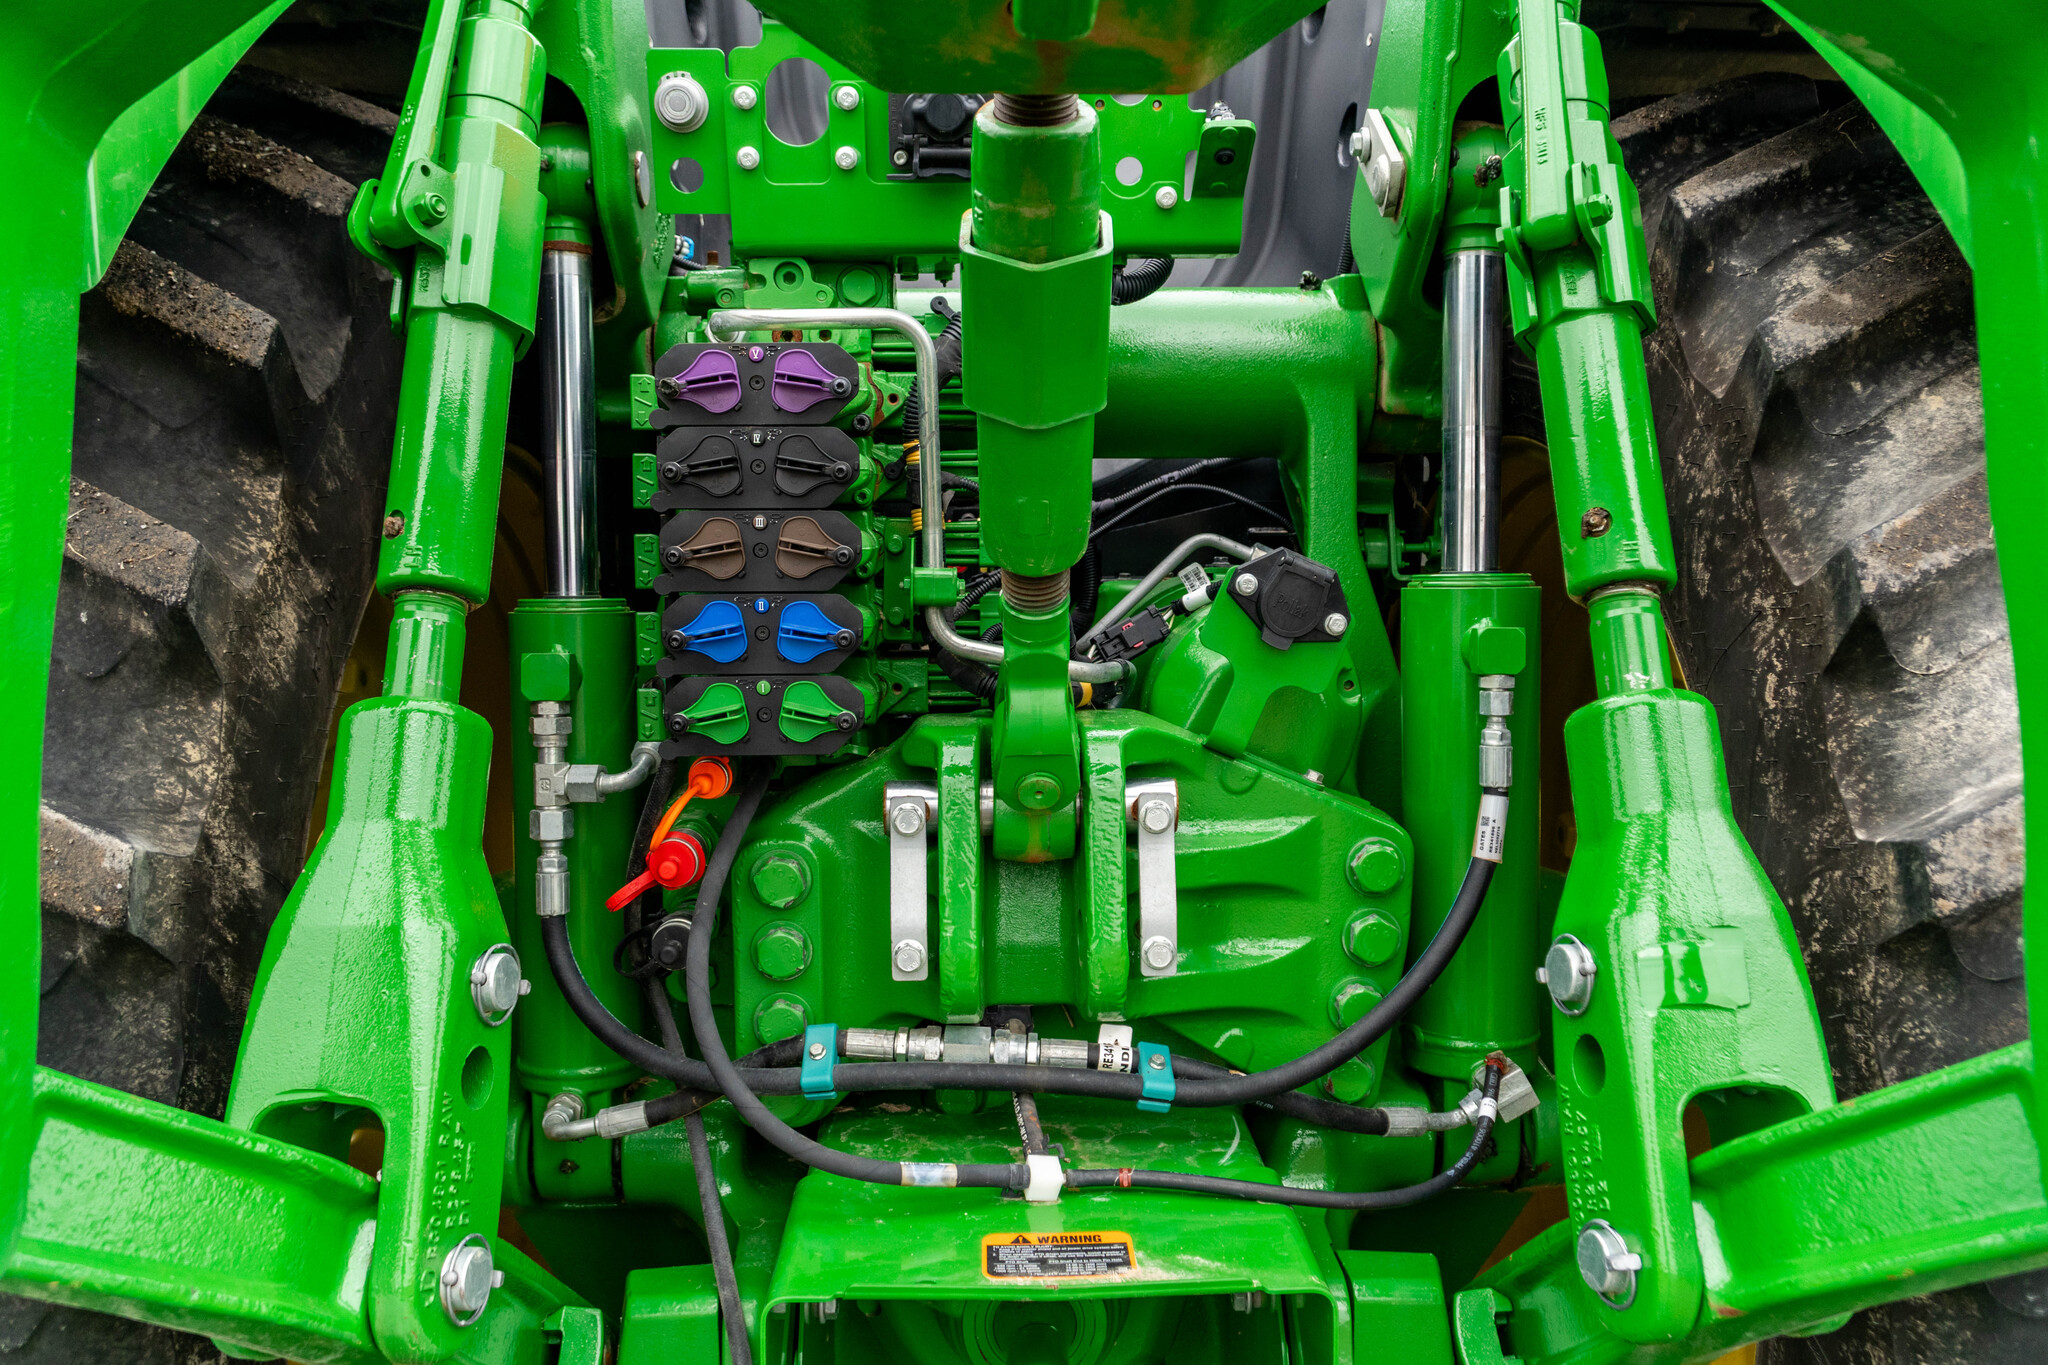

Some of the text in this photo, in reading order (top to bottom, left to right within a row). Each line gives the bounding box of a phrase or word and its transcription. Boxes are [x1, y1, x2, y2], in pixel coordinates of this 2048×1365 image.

[1272, 592, 1309, 619] Pollak
[438, 1091, 454, 1147] RAW
[1037, 1235, 1102, 1243] WARNING
